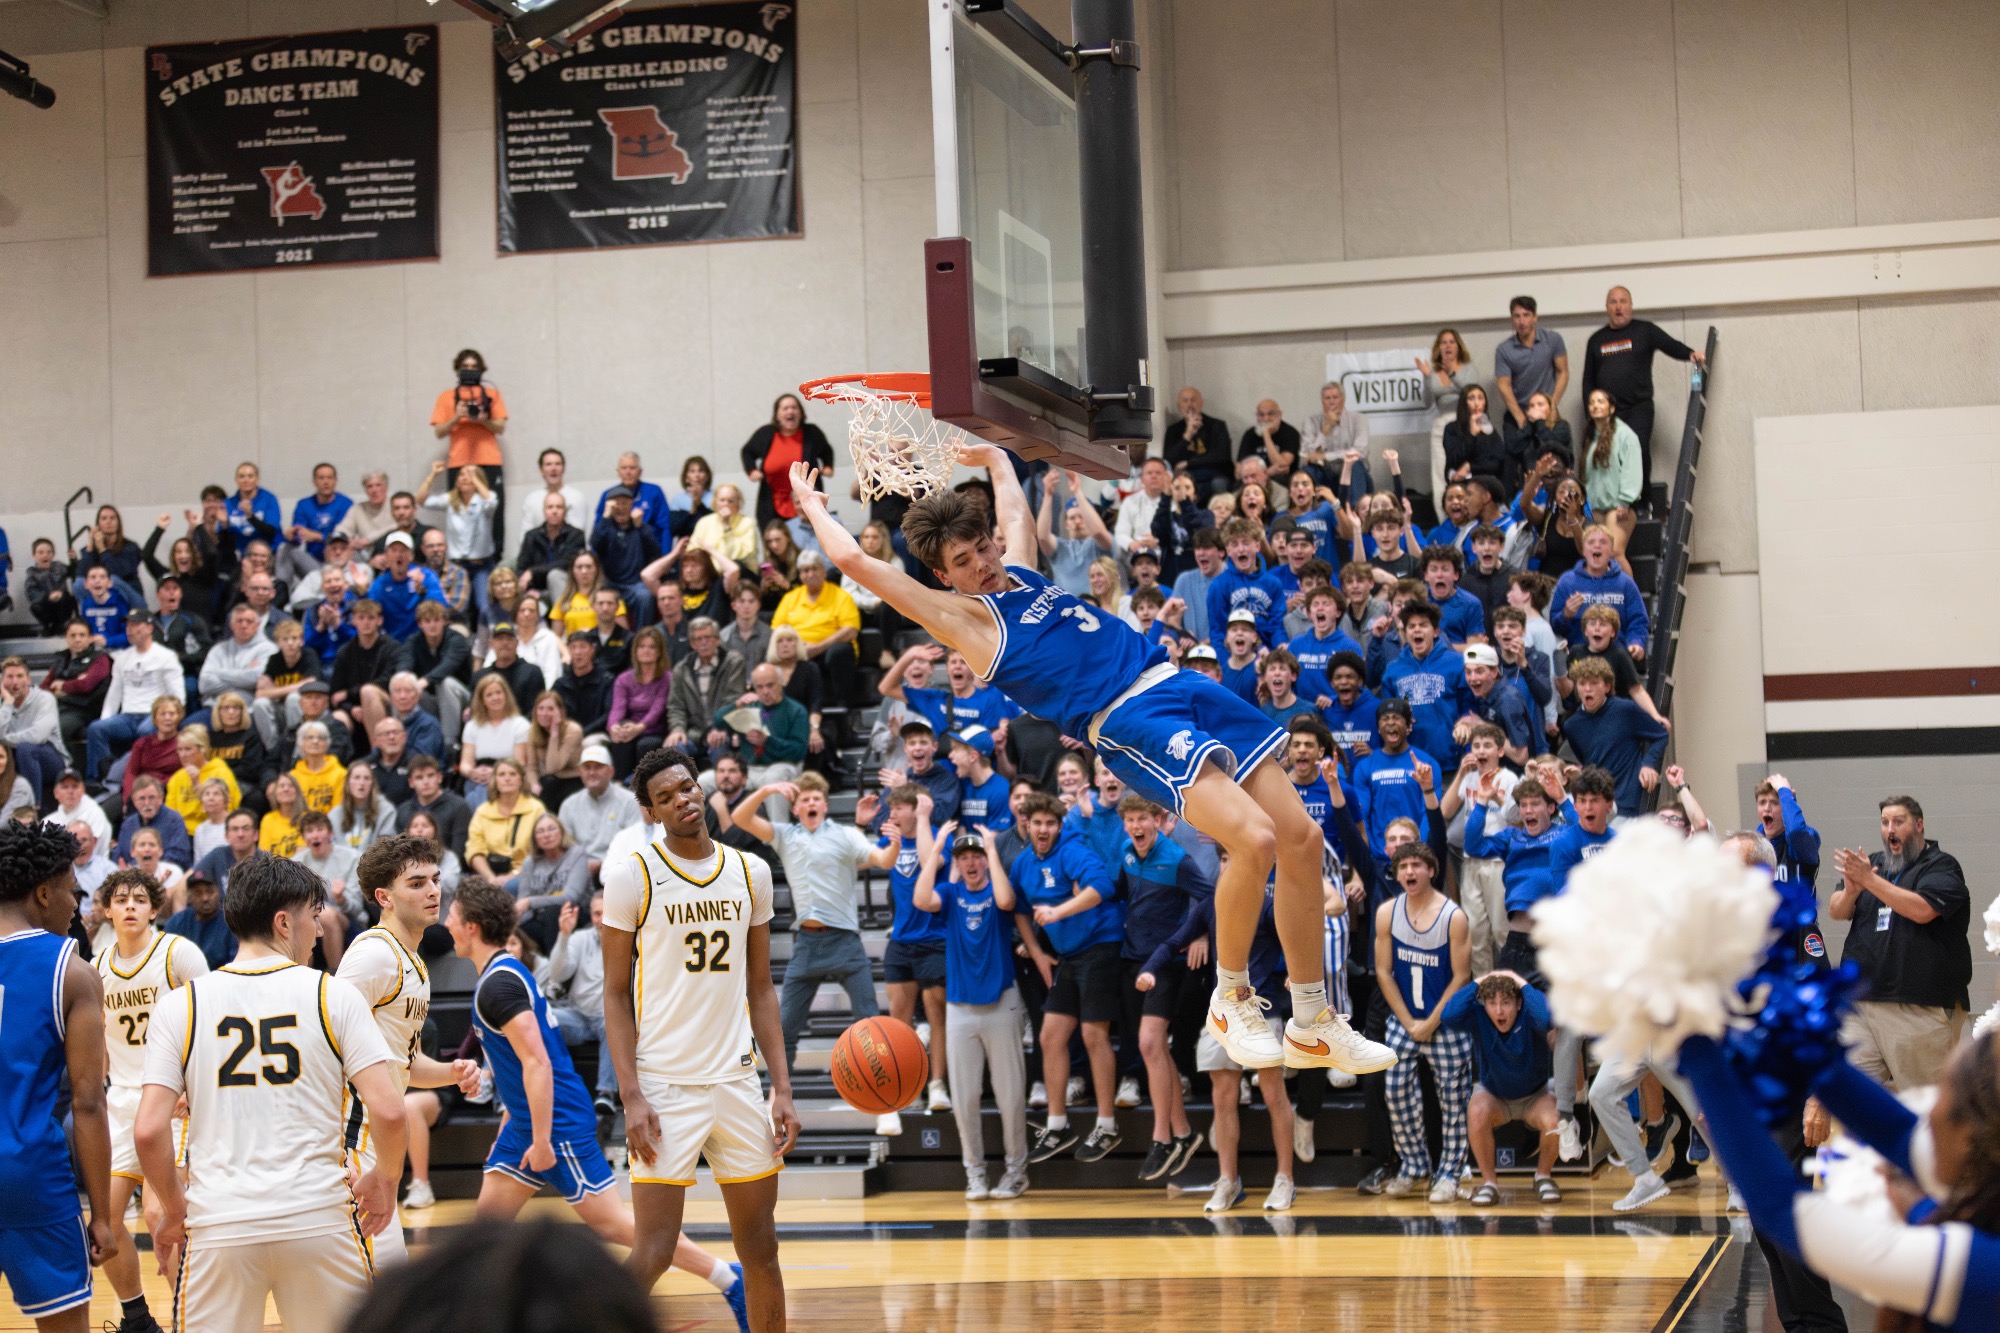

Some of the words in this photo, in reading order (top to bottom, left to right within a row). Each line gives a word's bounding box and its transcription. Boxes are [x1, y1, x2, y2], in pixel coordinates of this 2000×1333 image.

[602, 24, 783, 63] CHAMPIONS
[159, 58, 243, 107] STATE
[251, 49, 426, 86] CHAMPIONS
[560, 56, 728, 82] CHEERLEADING
[225, 84, 295, 106] DANCE
[298, 79, 359, 101] TEAM
[605, 79, 638, 91] Class
[650, 77, 685, 88] Small
[628, 215, 669, 230] 2015
[275, 249, 314, 263] 2021
[1353, 378, 1422, 404] VISITOR
[1060, 604, 1101, 633] 3
[664, 900, 742, 925] VIANNEY
[685, 929, 730, 973] 32
[1410, 966, 1425, 1010] 1
[216, 1014, 301, 1088] 25
